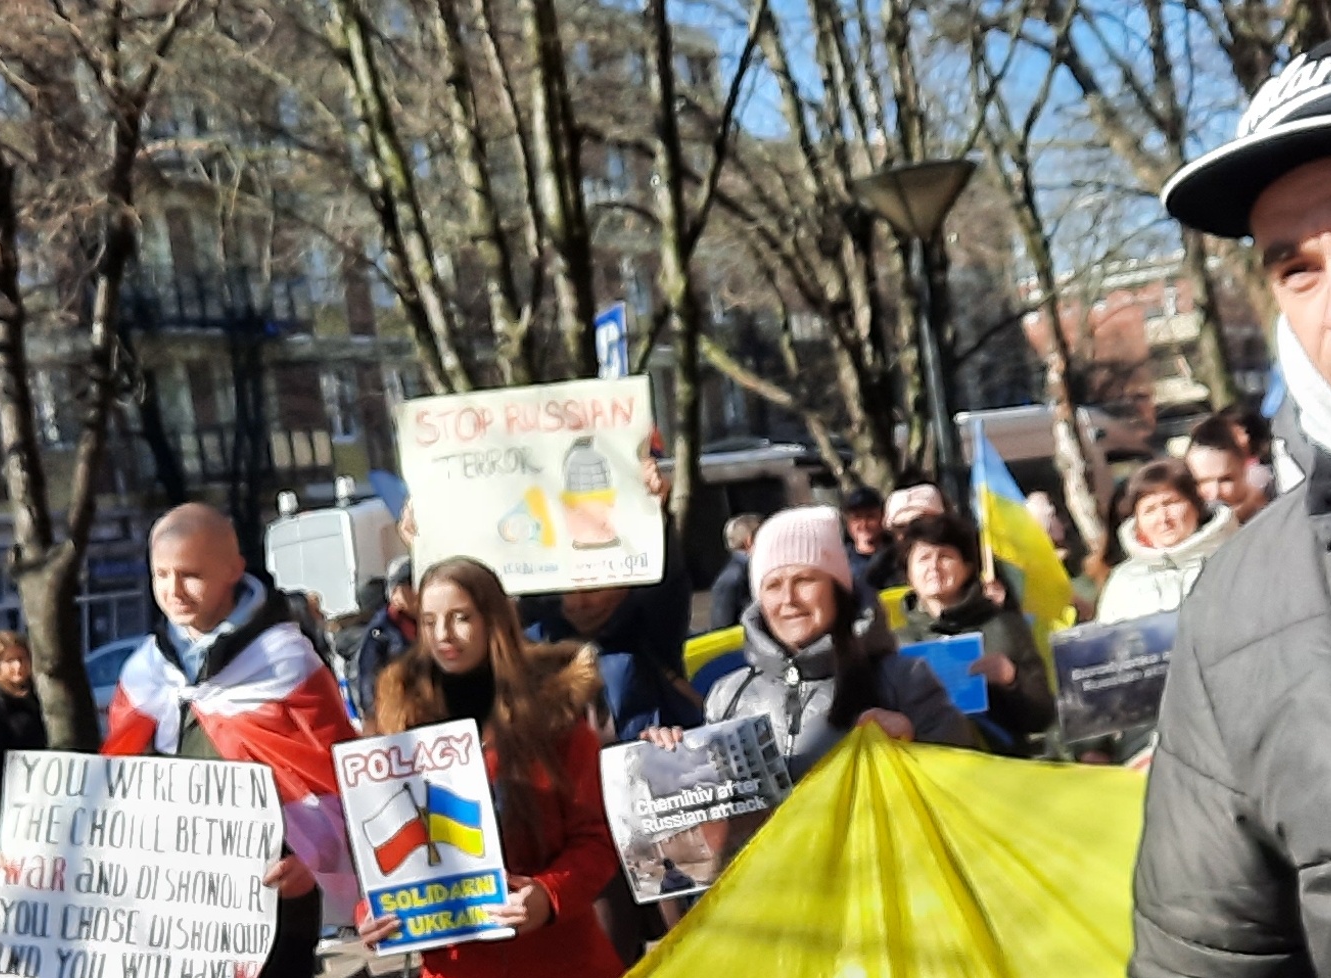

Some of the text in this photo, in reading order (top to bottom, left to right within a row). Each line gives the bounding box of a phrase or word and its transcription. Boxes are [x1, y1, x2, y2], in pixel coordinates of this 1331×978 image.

[415, 396, 634, 447] STOP RUSSIAN
[432, 446, 544, 480] TERROR
[20, 755, 268, 809] YOU WERE GIVEN
[343, 733, 472, 787] POLACY
[641, 795, 768, 834] Russian attack
[717, 778, 762, 801] after
[12, 803, 275, 861] THE CHOICE BETWEEN
[380, 875, 496, 912] SOLIDARNI
[0, 898, 271, 955] YOU CHOSE DISHONOUR
